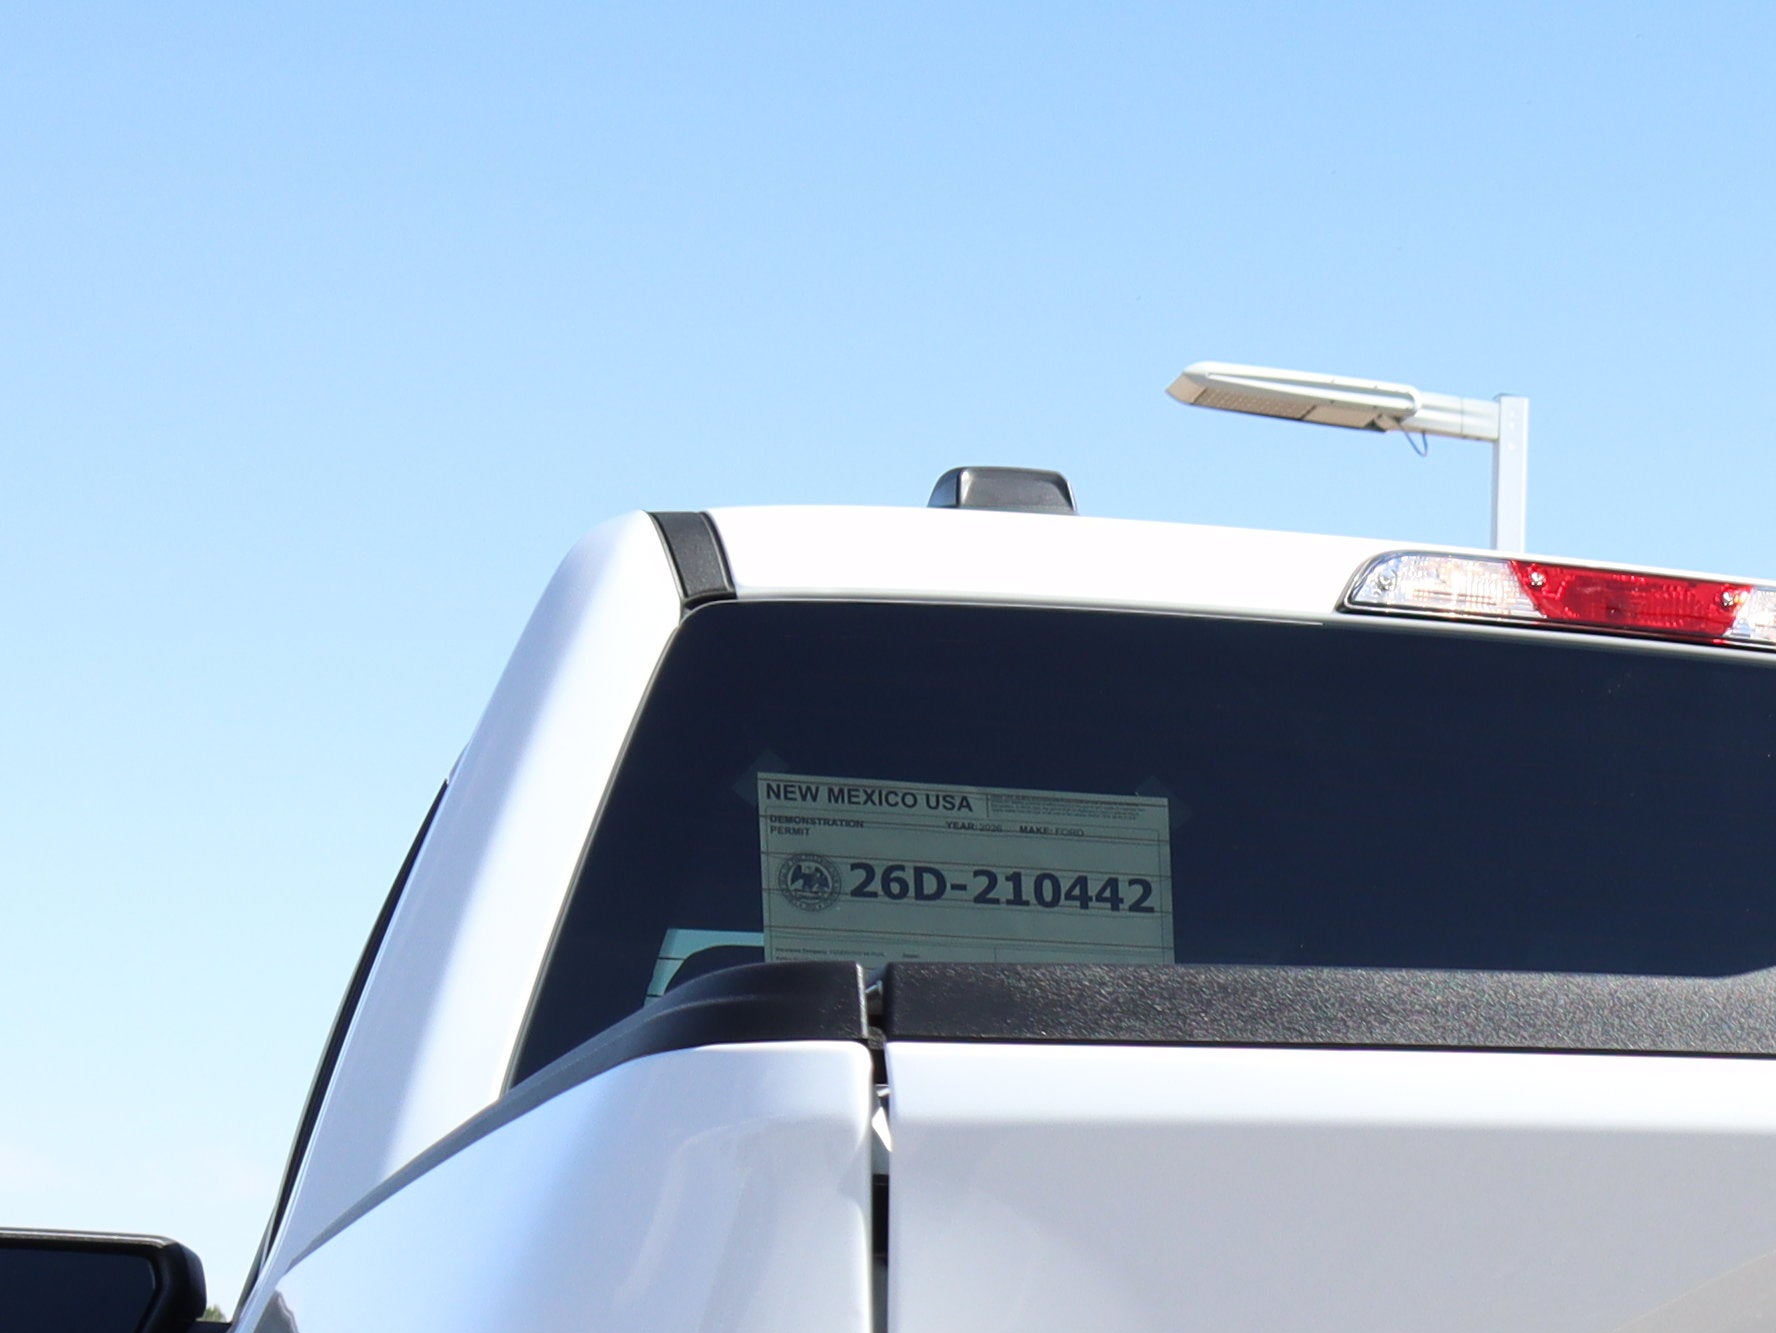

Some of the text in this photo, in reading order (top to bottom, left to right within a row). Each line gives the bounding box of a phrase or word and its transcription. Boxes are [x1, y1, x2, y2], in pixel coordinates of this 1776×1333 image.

[766, 783, 820, 803] NEW
[827, 787, 919, 808] MEXICO
[925, 793, 974, 813] USA
[769, 814, 865, 829] DEMONSTRATION
[769, 826, 811, 837] PERMIT
[848, 862, 1157, 915] 26D-210442
